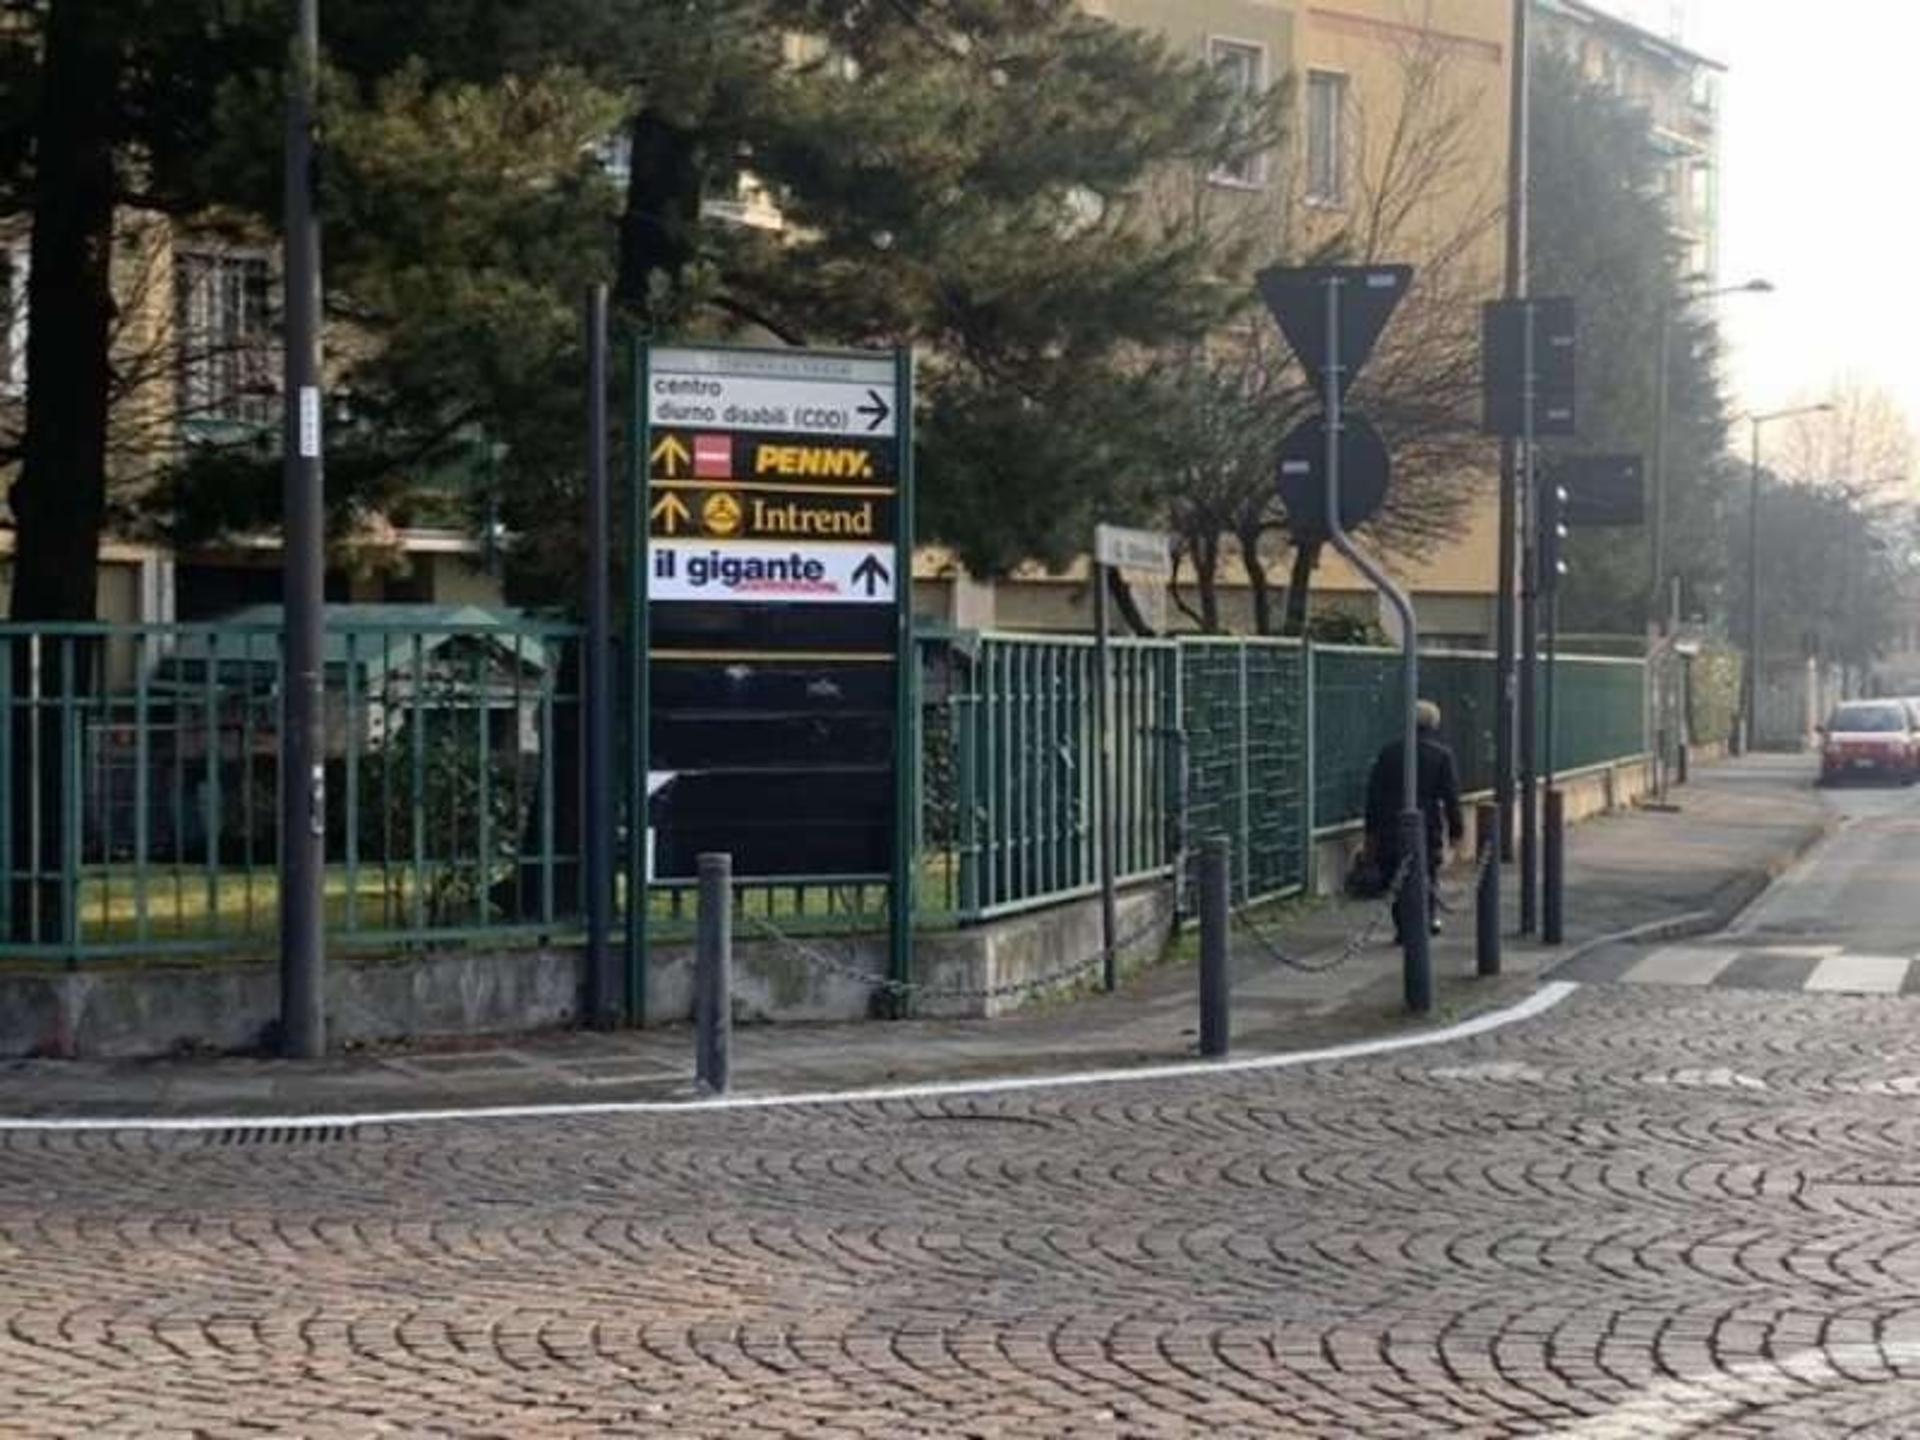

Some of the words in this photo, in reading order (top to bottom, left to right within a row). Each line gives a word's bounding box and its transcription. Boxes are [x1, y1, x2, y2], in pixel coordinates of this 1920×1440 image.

[654, 378, 722, 398] centro
[754, 500, 872, 535] Intrend
[655, 550, 675, 578] il
[687, 551, 825, 587] gigante
